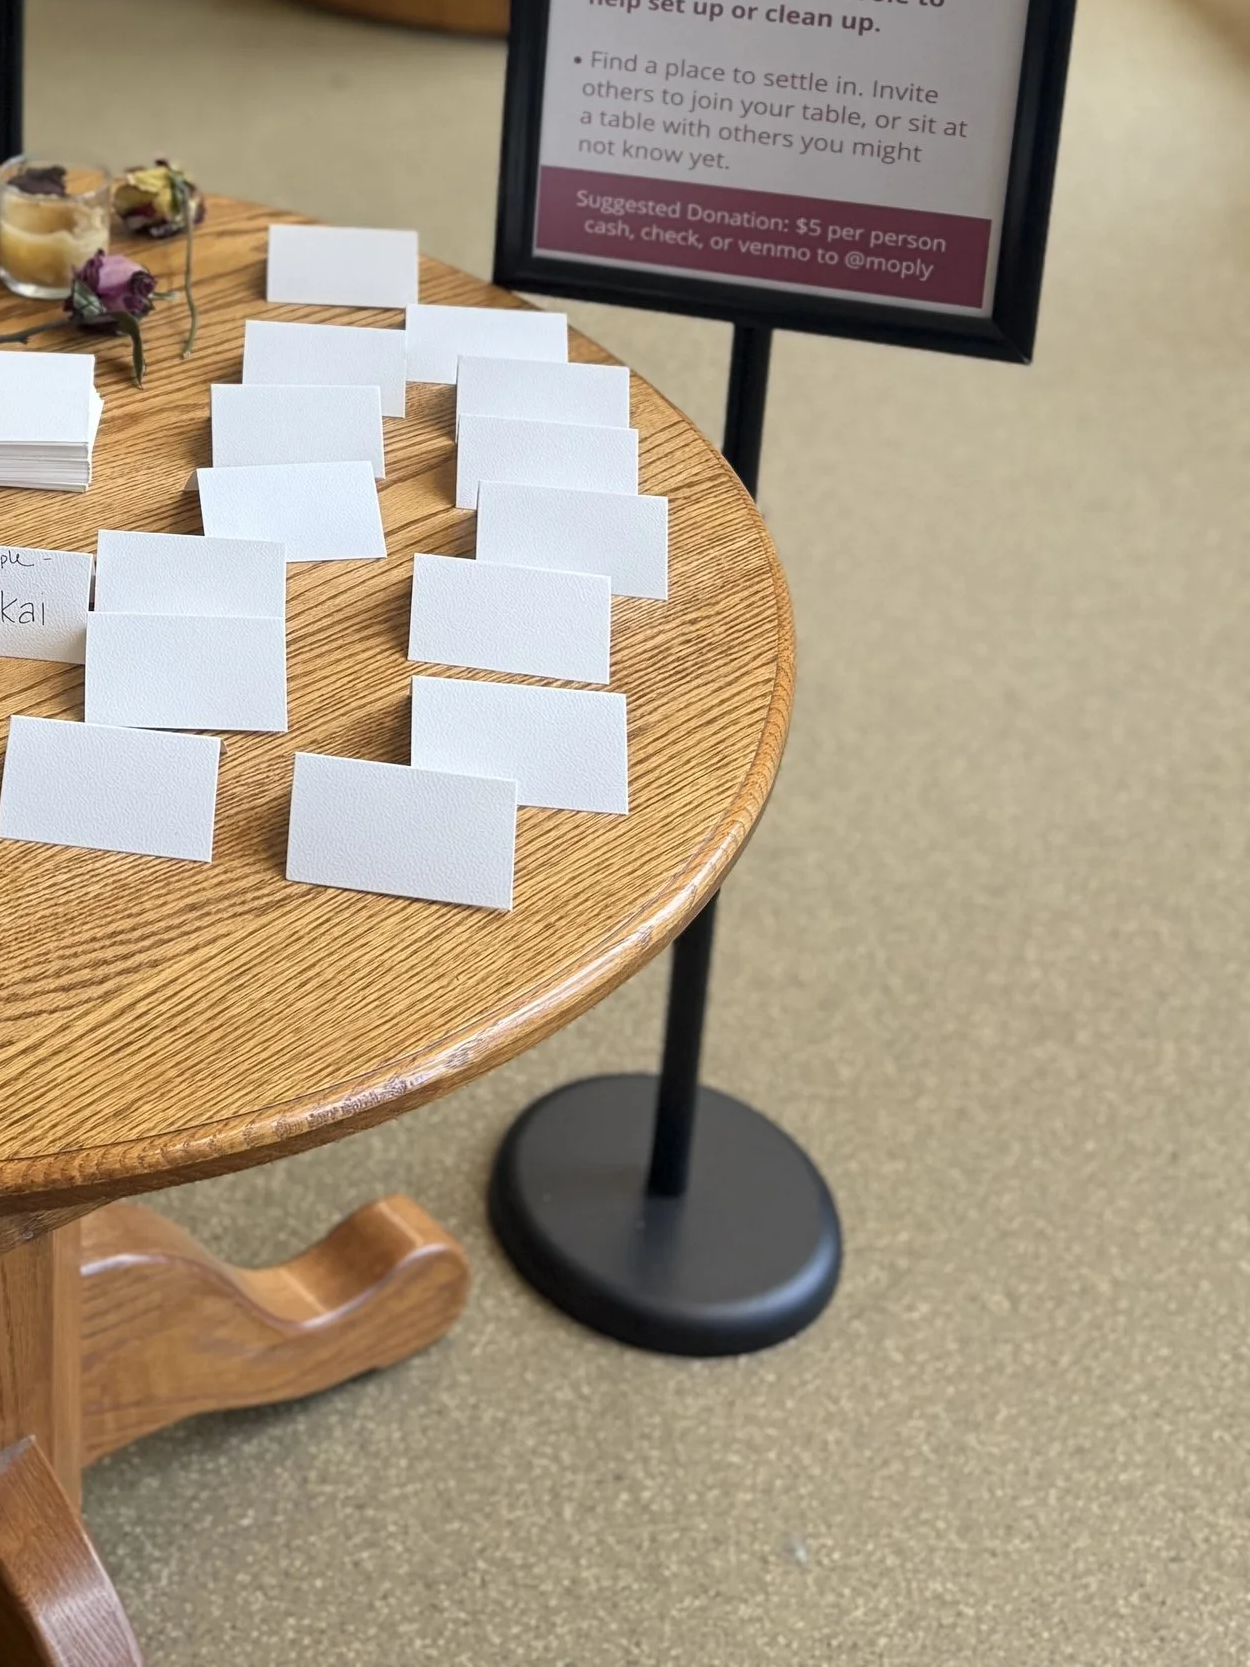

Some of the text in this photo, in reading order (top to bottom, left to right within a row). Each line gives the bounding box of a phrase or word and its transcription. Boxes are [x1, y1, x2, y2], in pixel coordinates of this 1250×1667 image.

[693, 1, 724, 22] up
[731, 4, 758, 20] or
[765, 3, 832, 28] clean
[841, 15, 880, 37] up.
[591, 51, 939, 104] Find a place to settle in. Invite
[580, 111, 923, 165] a table with others you might
[582, 81, 969, 141] others to join your table, or sit at
[578, 139, 730, 171] not know yet.
[576, 189, 946, 252] Suggested Donation: $5 per person
[583, 218, 934, 281] cash, check, or venmo to @moply
